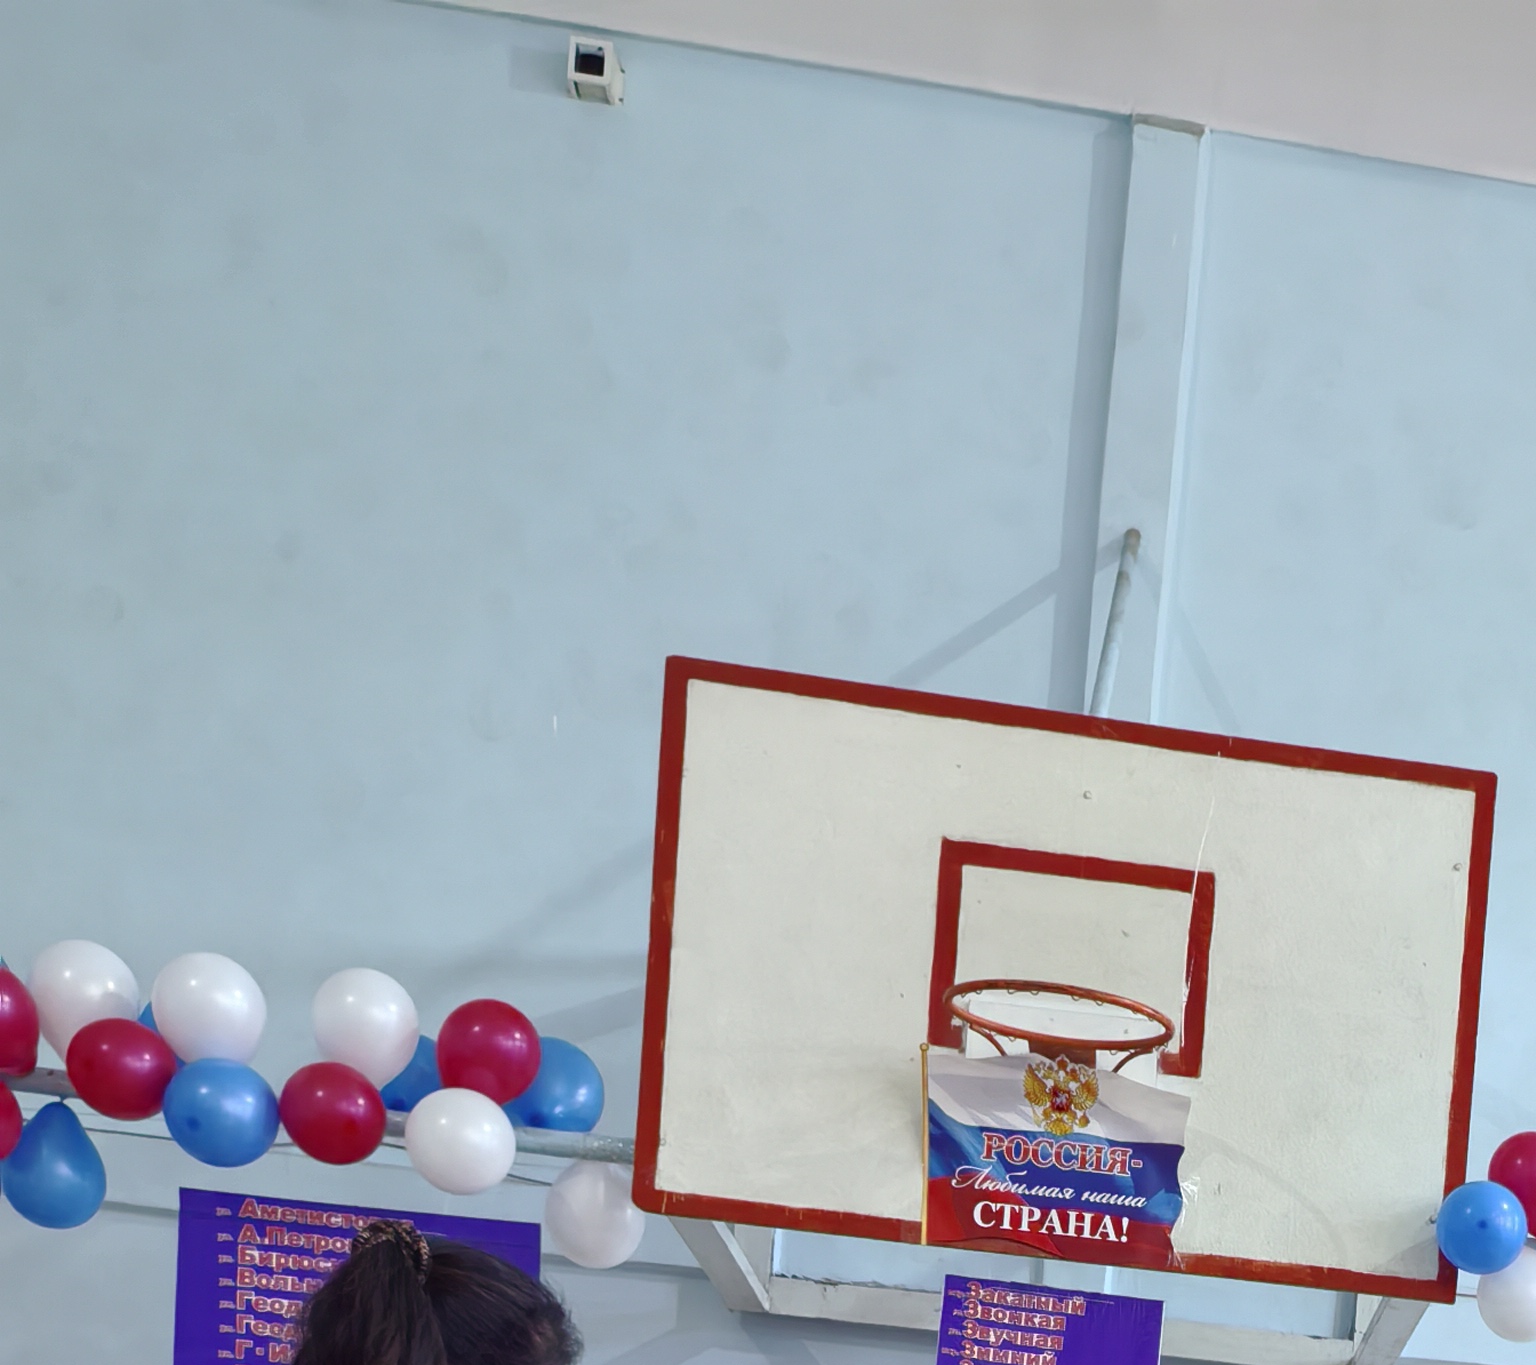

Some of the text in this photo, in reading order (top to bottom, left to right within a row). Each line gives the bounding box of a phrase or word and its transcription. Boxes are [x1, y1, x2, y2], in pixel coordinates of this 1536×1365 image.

[951, 1164, 1148, 1209] Любимая наша
[238, 1197, 415, 1231] Аметисто
[973, 1200, 1130, 1244] СТРАНА!
[238, 1244, 340, 1272] Бирюс
[237, 1267, 323, 1294] Вольн
[236, 1290, 303, 1318] Геод
[963, 1298, 1066, 1331] Звонкая
[966, 1281, 1087, 1316] Закатный
[961, 1319, 1064, 1350] Звучная
